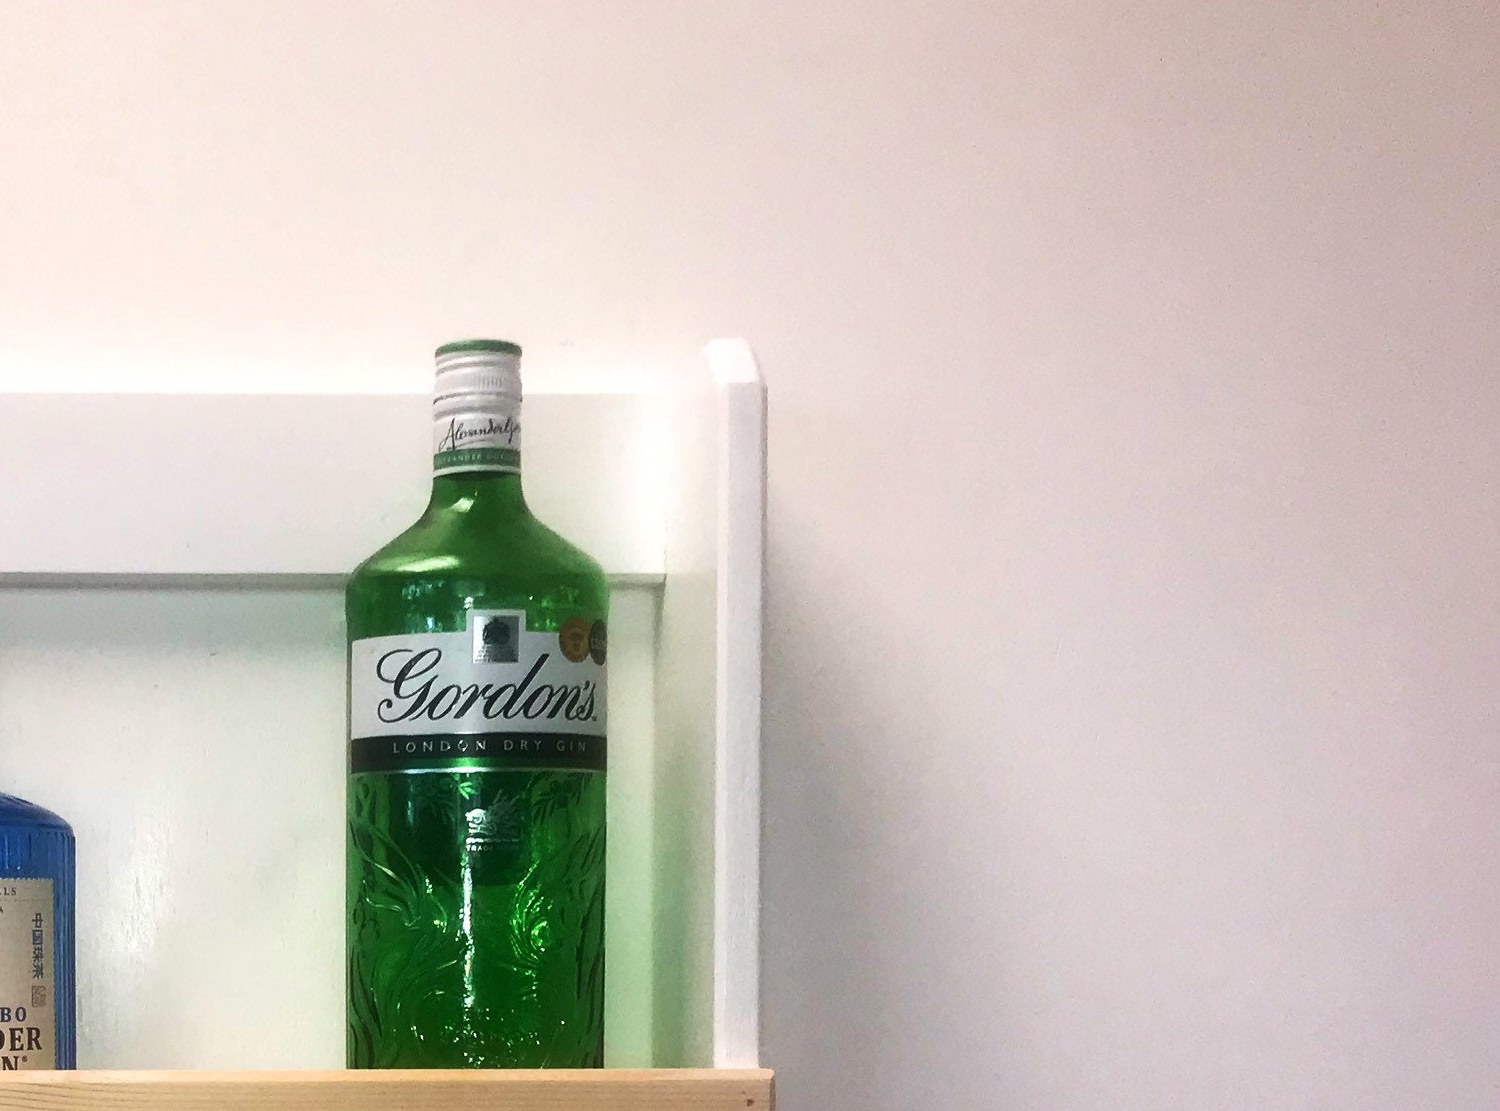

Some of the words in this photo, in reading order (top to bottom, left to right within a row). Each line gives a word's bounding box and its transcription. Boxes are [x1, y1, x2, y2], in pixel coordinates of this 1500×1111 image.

[376, 647, 597, 724] Gordon's
[392, 739, 487, 754] LONDON
[503, 739, 543, 751] DRY
[556, 739, 587, 751] GIN
